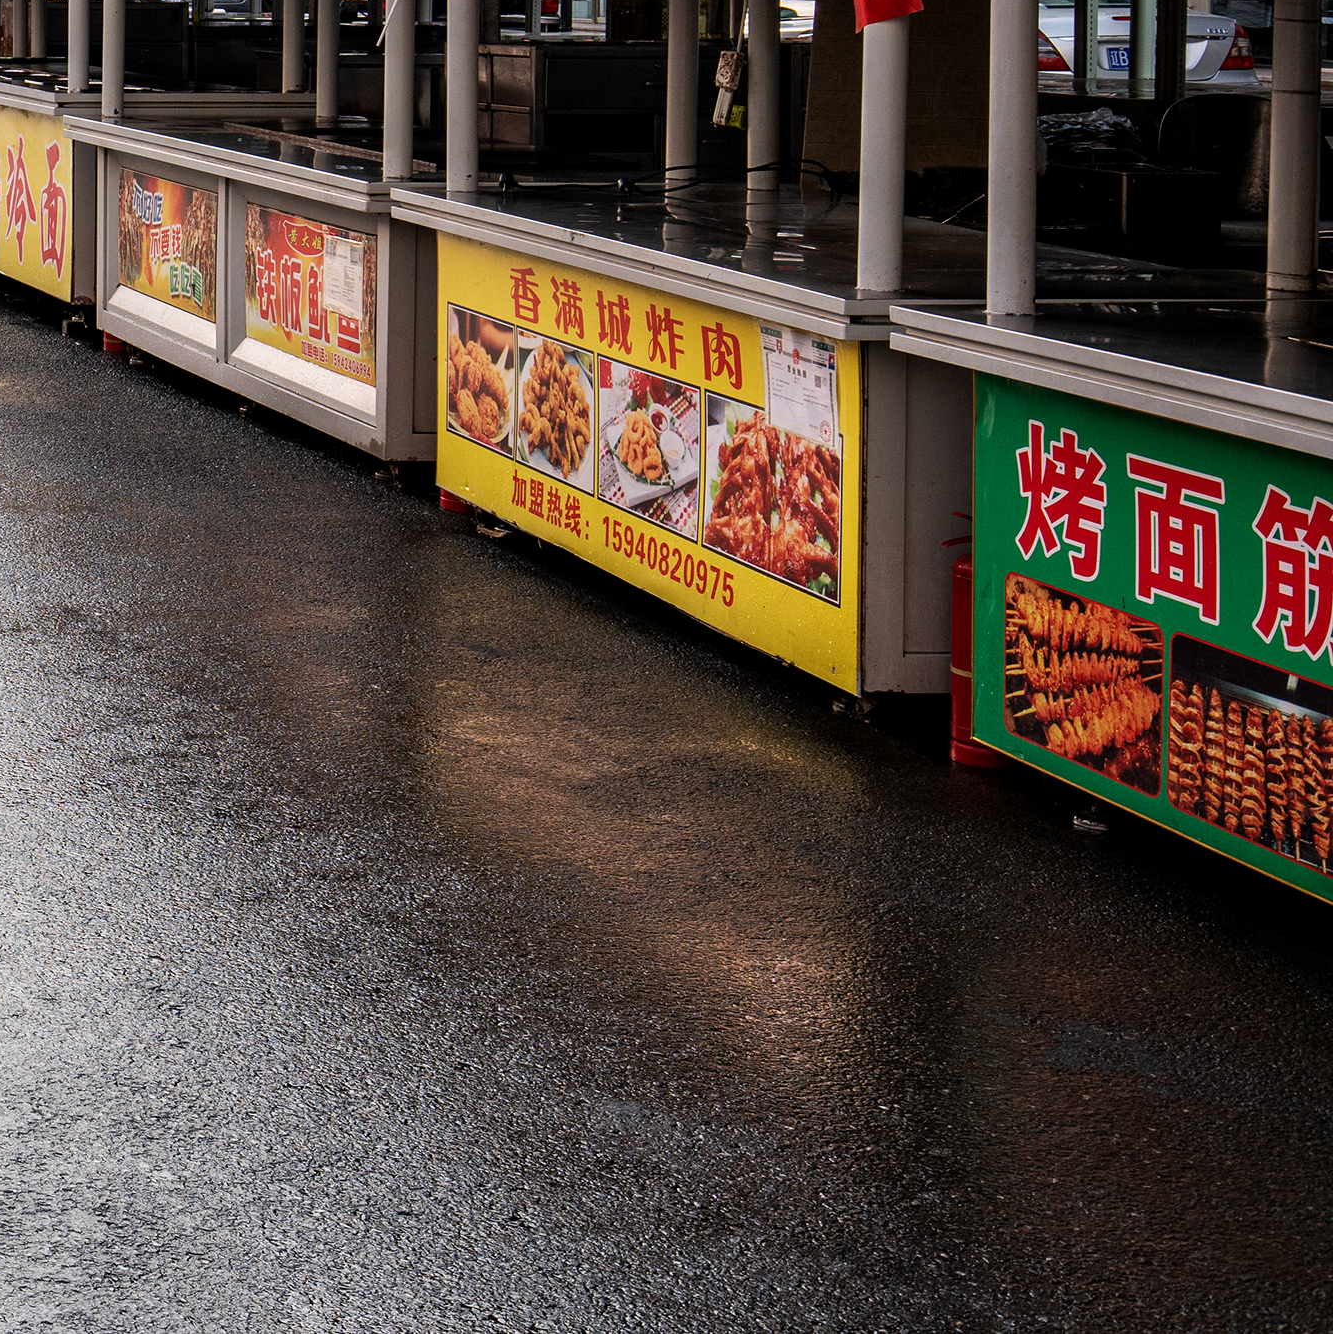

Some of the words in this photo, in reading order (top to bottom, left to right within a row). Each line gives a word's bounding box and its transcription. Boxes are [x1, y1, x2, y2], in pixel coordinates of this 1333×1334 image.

[133, 179, 165, 226] 不好吃
[150, 223, 183, 266] 不要钱
[287, 226, 325, 252] 黄大姐
[169, 261, 204, 307] 吃吃看
[509, 266, 743, 391] 香满城炸肉
[511, 468, 736, 609] 加盟热线：15940820975
[1015, 418, 1333, 662] 烤面筋
